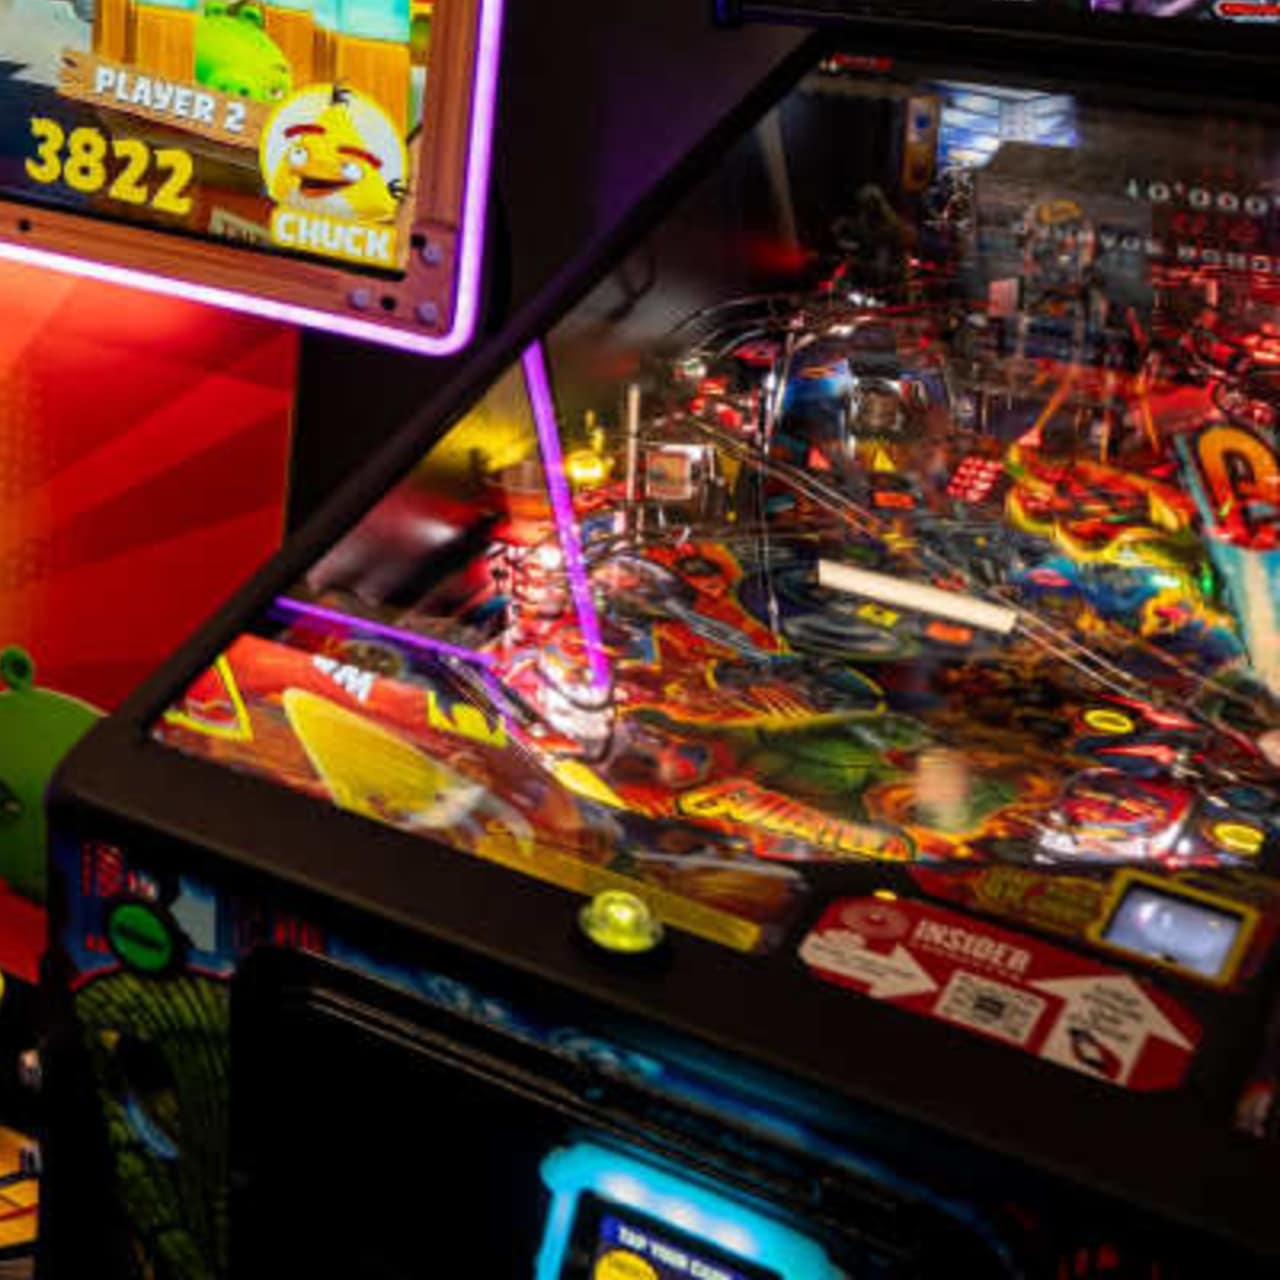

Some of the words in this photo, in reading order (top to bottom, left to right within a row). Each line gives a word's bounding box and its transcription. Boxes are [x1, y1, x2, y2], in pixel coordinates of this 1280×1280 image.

[94, 65, 216, 127] PLAYER
[224, 100, 248, 135] 2
[23, 116, 196, 216] 3822
[277, 212, 390, 261] CHUCK
